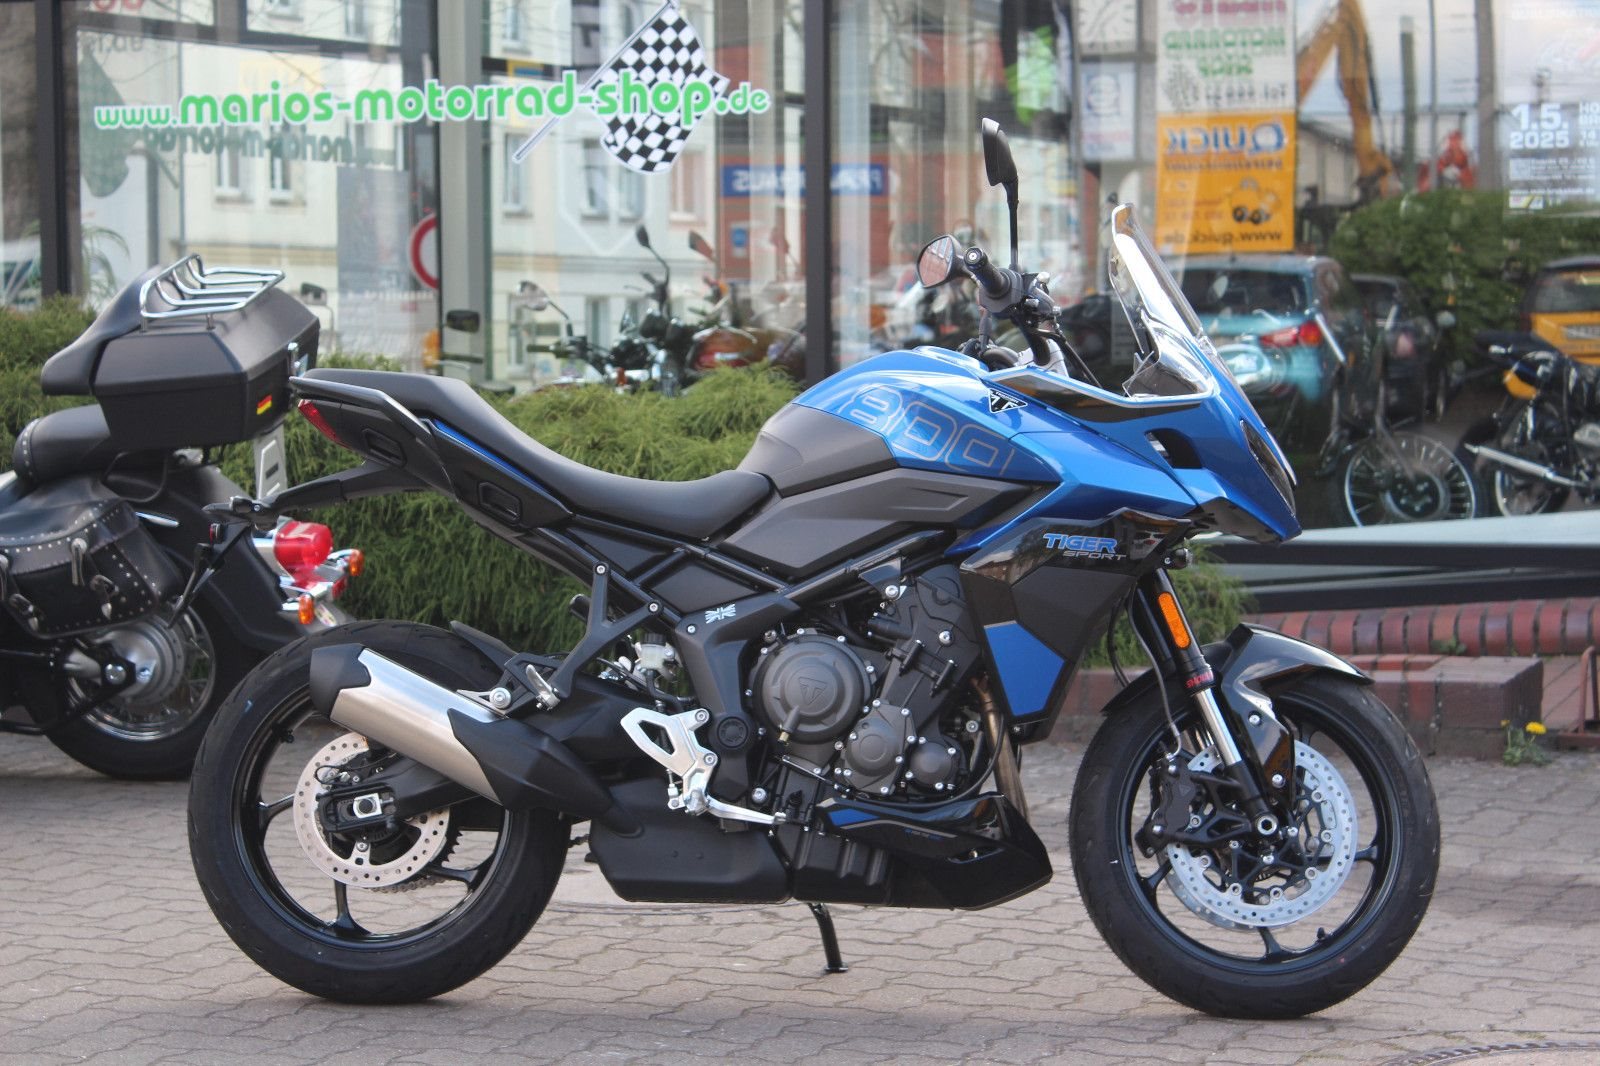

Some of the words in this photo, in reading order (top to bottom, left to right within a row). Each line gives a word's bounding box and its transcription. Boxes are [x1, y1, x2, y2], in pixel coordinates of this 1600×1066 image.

[95, 71, 770, 129] www.marios-motorrad-shop.de
[1511, 103, 1569, 131] 1.5.
[1510, 131, 1570, 149] 2025
[836, 383, 1015, 476] 800
[1043, 533, 1118, 554] TIGER
[1063, 550, 1127, 561] SPORT
